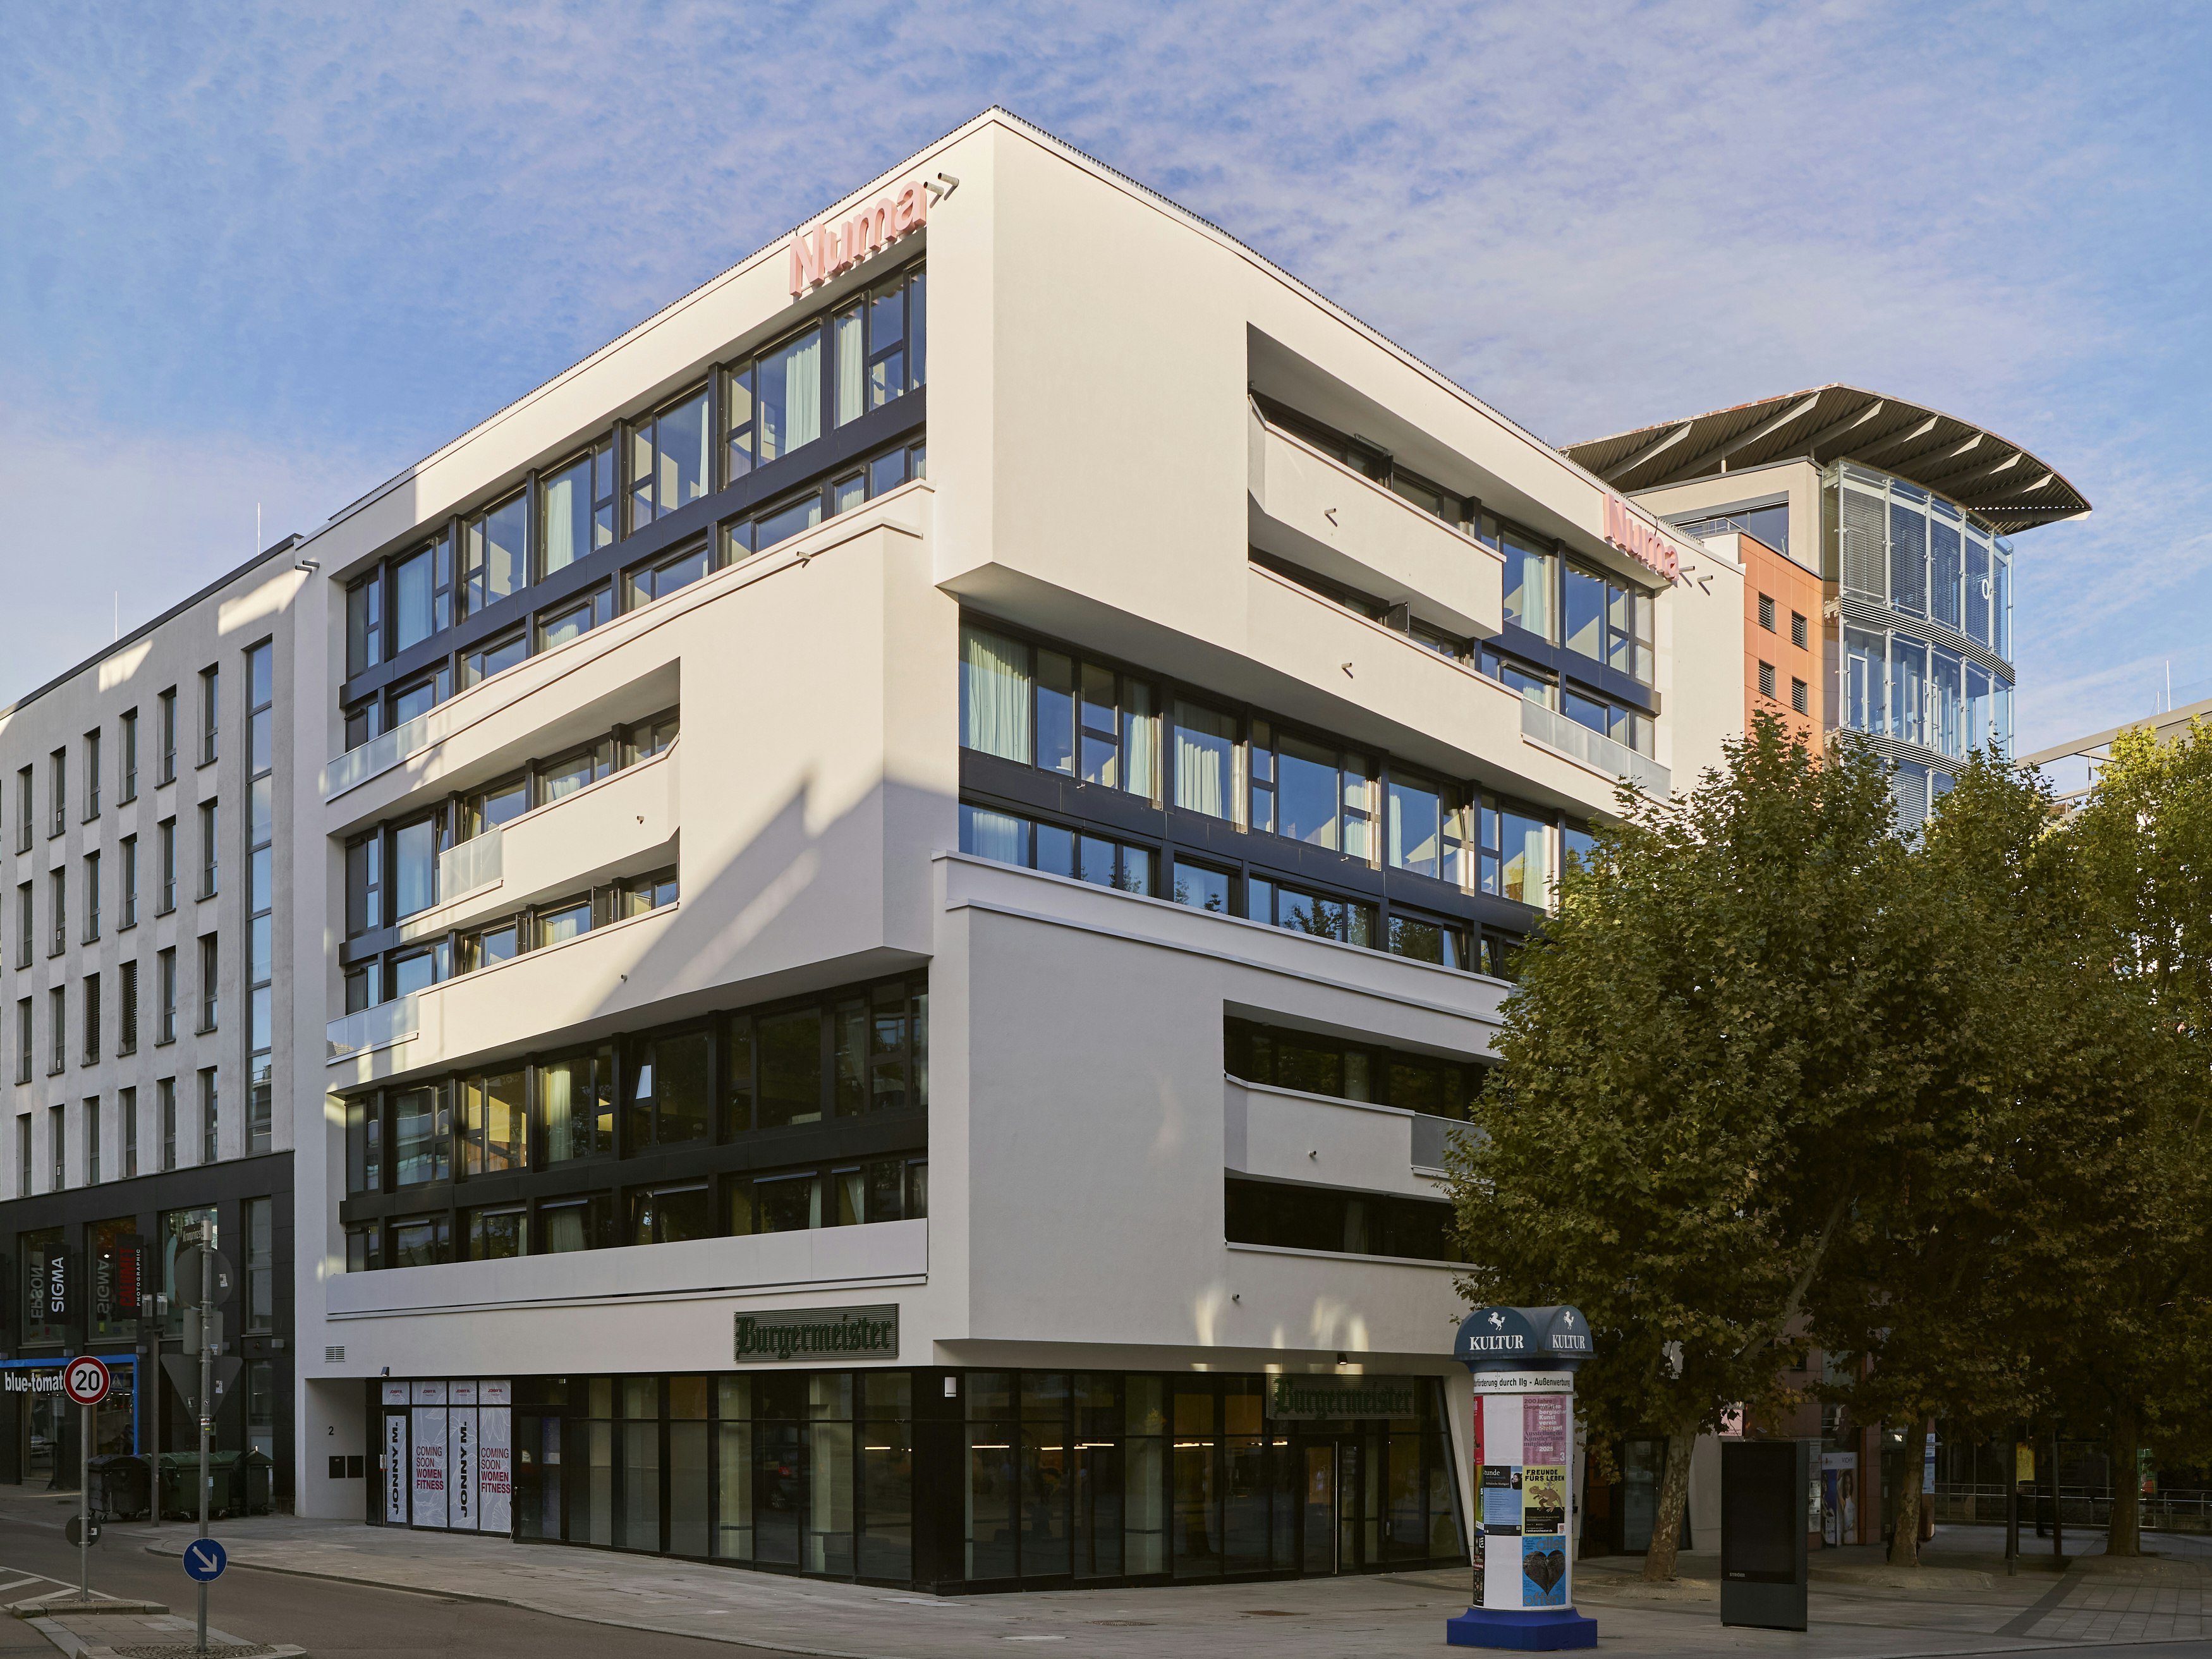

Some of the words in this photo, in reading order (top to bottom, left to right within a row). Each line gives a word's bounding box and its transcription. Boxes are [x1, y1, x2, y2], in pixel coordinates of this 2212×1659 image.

[789, 181, 927, 297] Numa
[1603, 493, 1679, 581] Numa
[183, 1228, 201, 1243] Kronprinzs
[51, 1256, 65, 1313] SIGMA
[735, 1314, 892, 1359] Burgermeister
[1469, 1335, 1524, 1351] KULTUR
[1552, 1334, 1586, 1349] KULTUR
[4, 1370, 64, 1392] blue-tomat
[75, 1370, 100, 1391] 20
[1499, 1378, 1517, 1387] durch
[1519, 1378, 1528, 1387] Ilg
[1534, 1378, 1571, 1387] Außenwerbung
[328, 1426, 334, 1435] 2
[392, 1422, 399, 1443] M.
[461, 1421, 467, 1443] M.
[416, 1446, 442, 1457] COMING
[481, 1448, 509, 1459] COMING
[416, 1457, 435, 1468] SOON
[481, 1459, 501, 1469] SOON
[416, 1469, 442, 1479] WOMEN
[481, 1471, 509, 1481] WOMEN
[416, 1480, 444, 1490] FITNESS
[481, 1482, 511, 1493] FITNESS
[1524, 1591, 1563, 1606] offen
